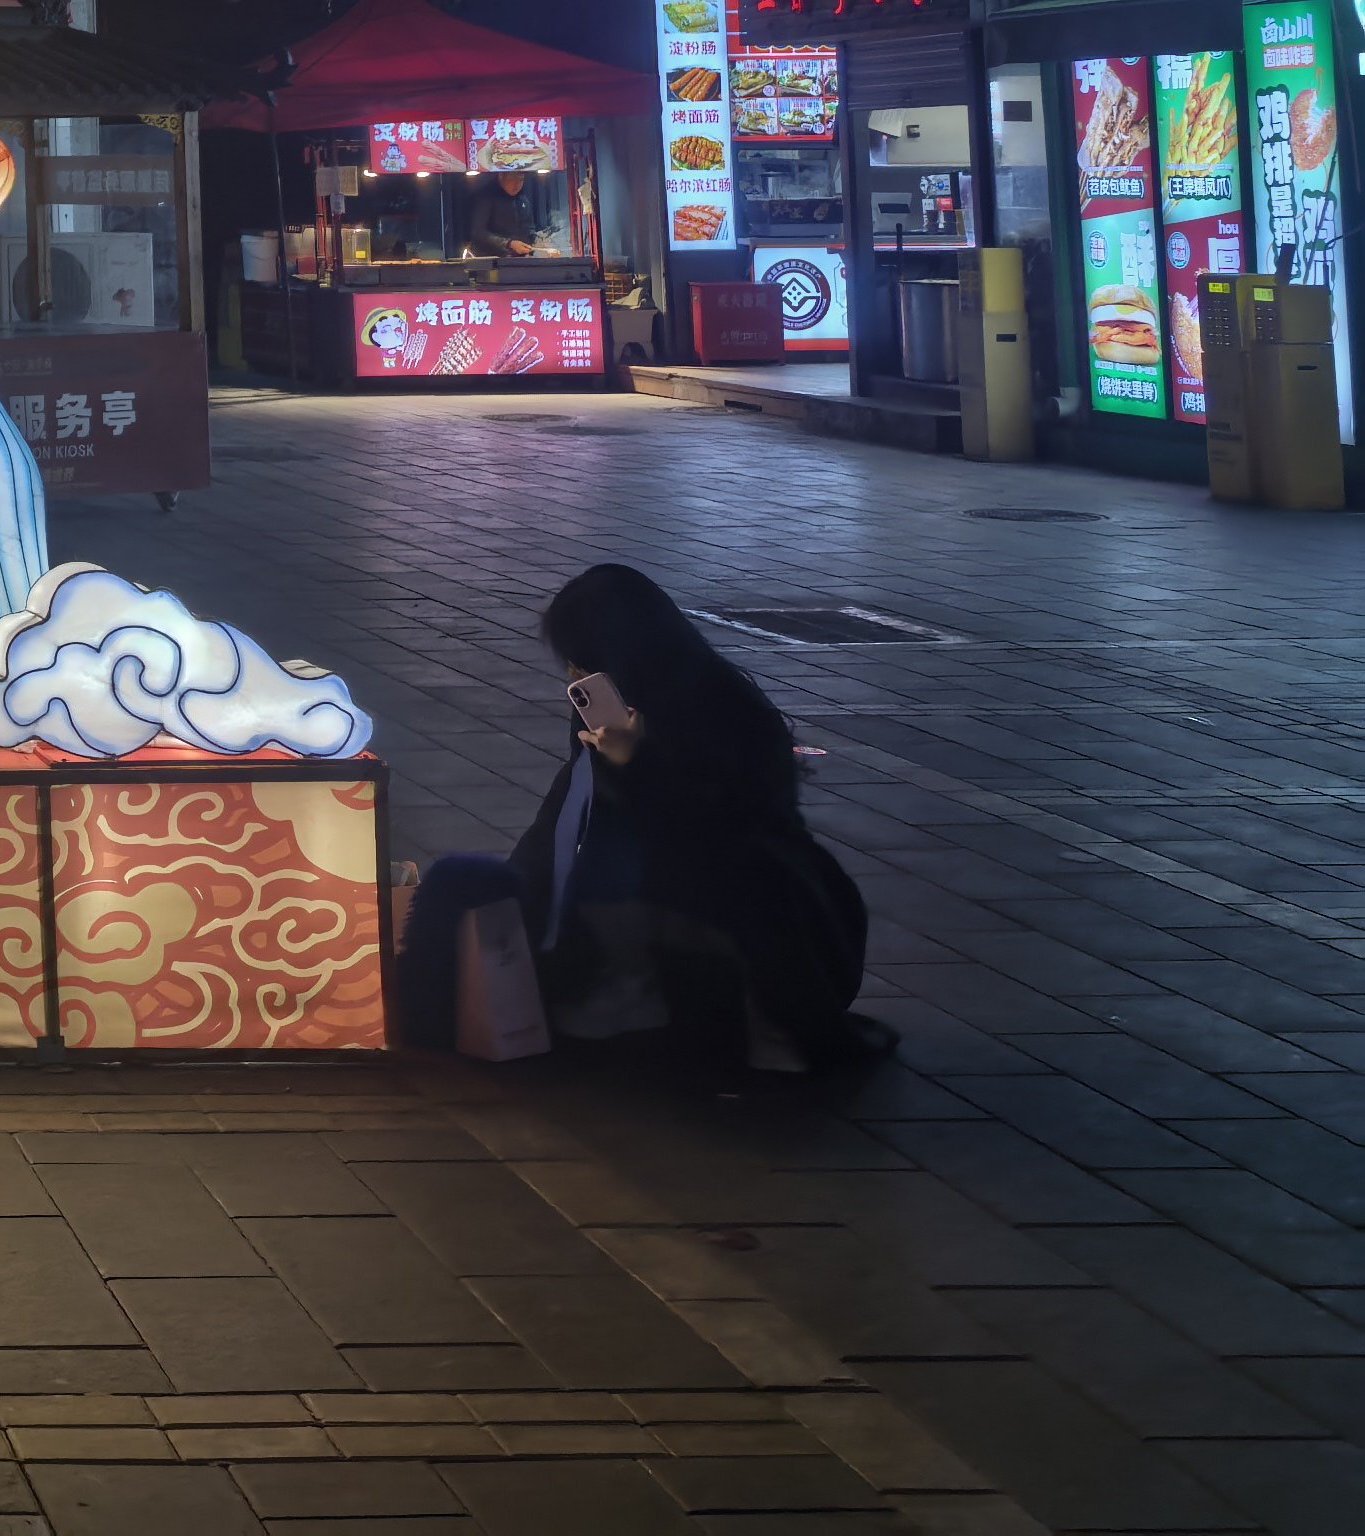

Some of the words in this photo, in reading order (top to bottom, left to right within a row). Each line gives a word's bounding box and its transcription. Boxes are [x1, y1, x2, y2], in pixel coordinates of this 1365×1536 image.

[1260, 13, 1314, 45] 卤山川
[669, 41, 717, 56] 淀粉肠
[1263, 45, 1314, 68] 卤味炸串
[670, 109, 720, 125] 烤面筋
[666, 177, 732, 194] 哈尔滨红肠
[415, 299, 493, 326] 烤面筋
[510, 297, 594, 324] 淀粉肠
[9, 390, 137, 441] 服务亭
[55, 443, 95, 458] KIOSK
